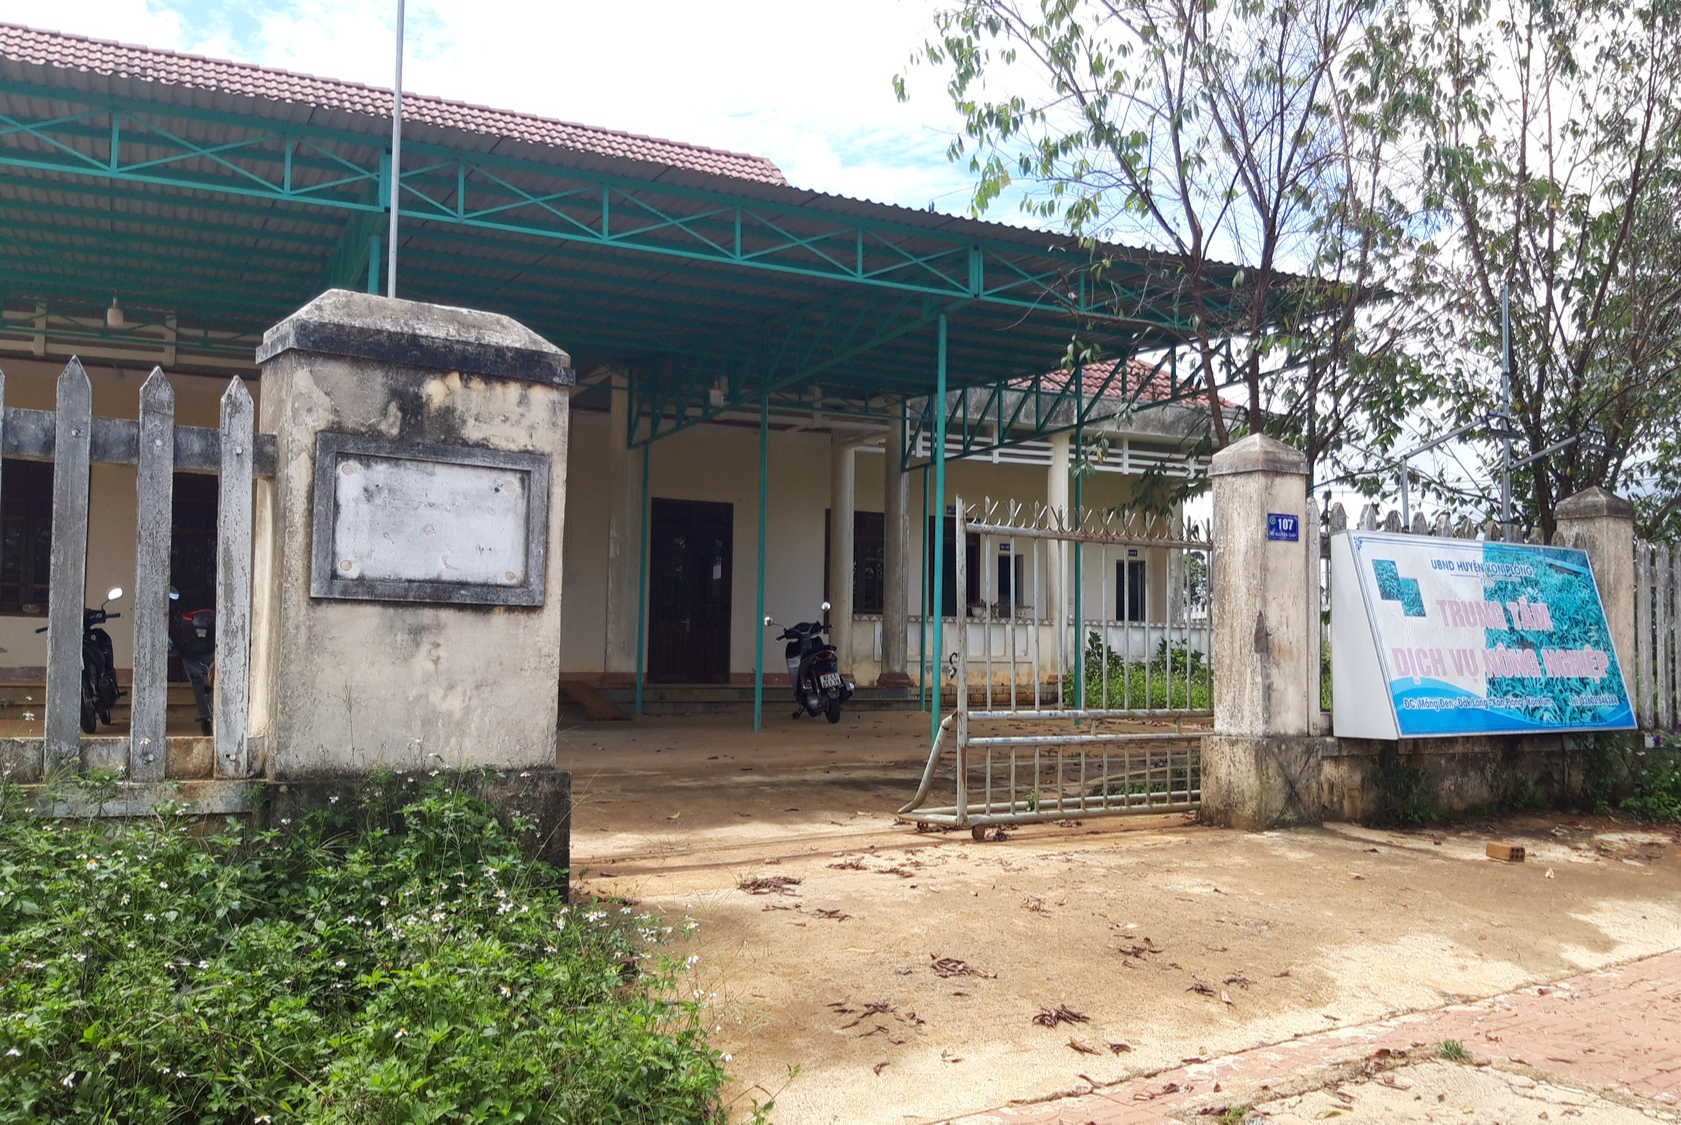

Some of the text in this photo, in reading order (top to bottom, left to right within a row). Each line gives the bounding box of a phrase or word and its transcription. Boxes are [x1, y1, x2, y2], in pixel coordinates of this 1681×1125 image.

[1278, 518, 1294, 531] 107
[1430, 558, 1455, 571] UBND
[1456, 559, 1485, 576] HUYỆN
[1485, 563, 1504, 575] KON
[1436, 596, 1554, 631] TRUNG TÂM
[1391, 642, 1610, 684] DỊCH VỤ NÔNG NGHIỆP
[1403, 698, 1417, 709] ĐC:
[1471, 697, 1489, 710] Long
[1492, 697, 1504, 707] Kon
